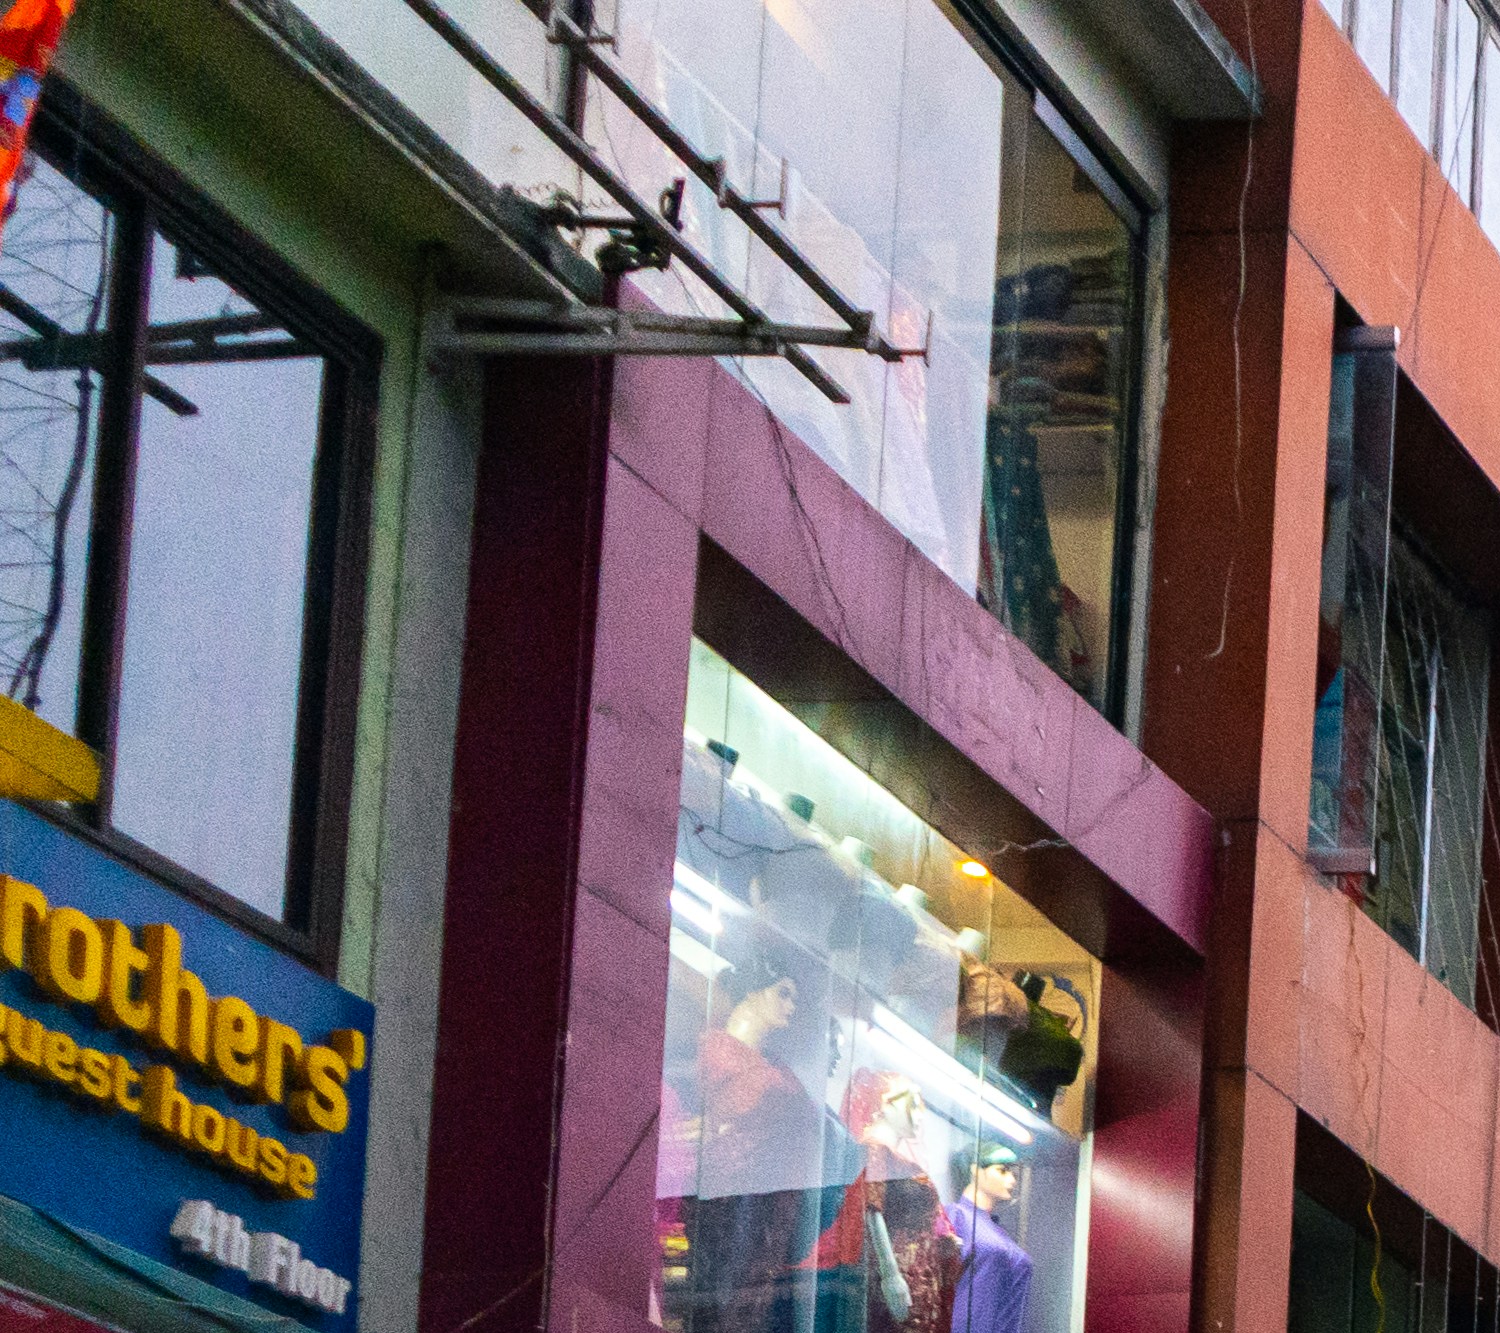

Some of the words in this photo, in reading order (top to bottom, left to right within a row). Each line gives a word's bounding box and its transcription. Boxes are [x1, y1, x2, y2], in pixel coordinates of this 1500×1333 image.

[0, 1003, 141, 1113] uest
[143, 1064, 318, 1198] house
[170, 1199, 250, 1271] 4th
[250, 1232, 352, 1316] Floor
